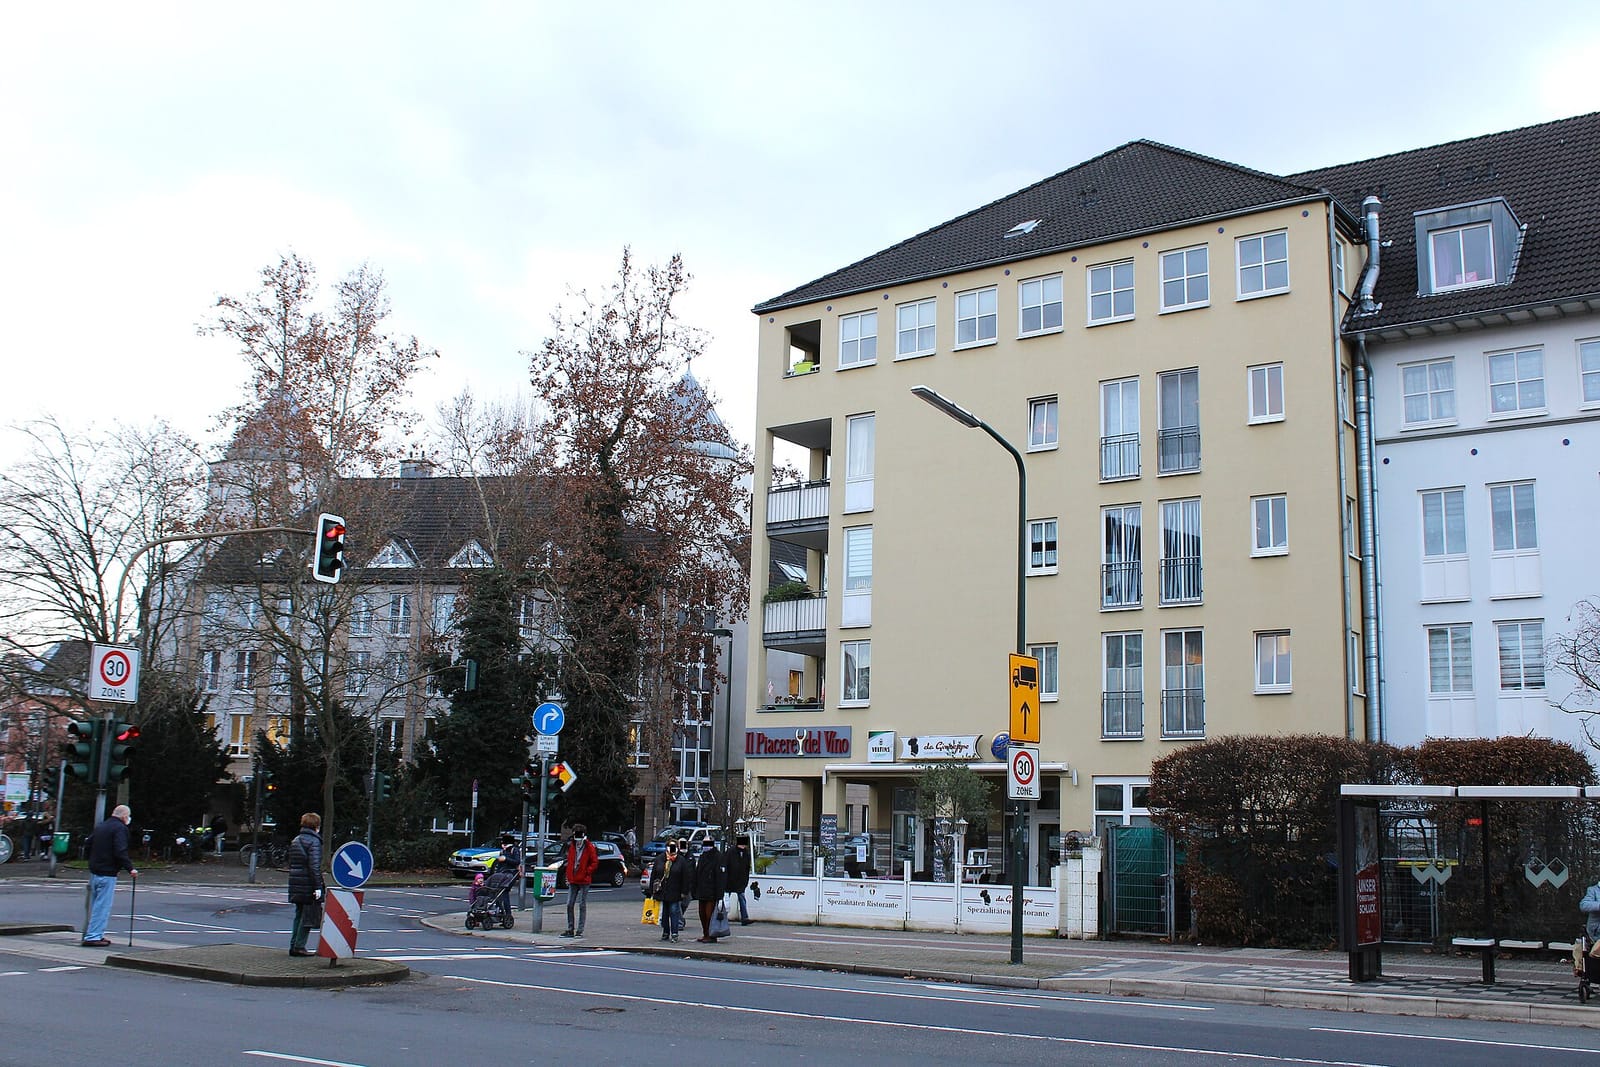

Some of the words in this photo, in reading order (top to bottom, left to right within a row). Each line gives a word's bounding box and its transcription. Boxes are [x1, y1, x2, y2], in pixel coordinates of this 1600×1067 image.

[106, 659, 125, 677] 30
[101, 687, 126, 698] ZONE
[745, 731, 754, 754] Il
[756, 732, 798, 754] Piacere
[803, 730, 821, 754] del
[823, 730, 849, 754] Vino
[923, 742, 934, 750] da
[1017, 759, 1030, 776] 30
[1016, 786, 1033, 796] ZONE
[1358, 878, 1376, 892] UNSER
[766, 886, 776, 894] da
[776, 886, 806, 899] Giuseppe
[866, 899, 899, 909] Ristorante
[1015, 908, 1050, 917] torante
